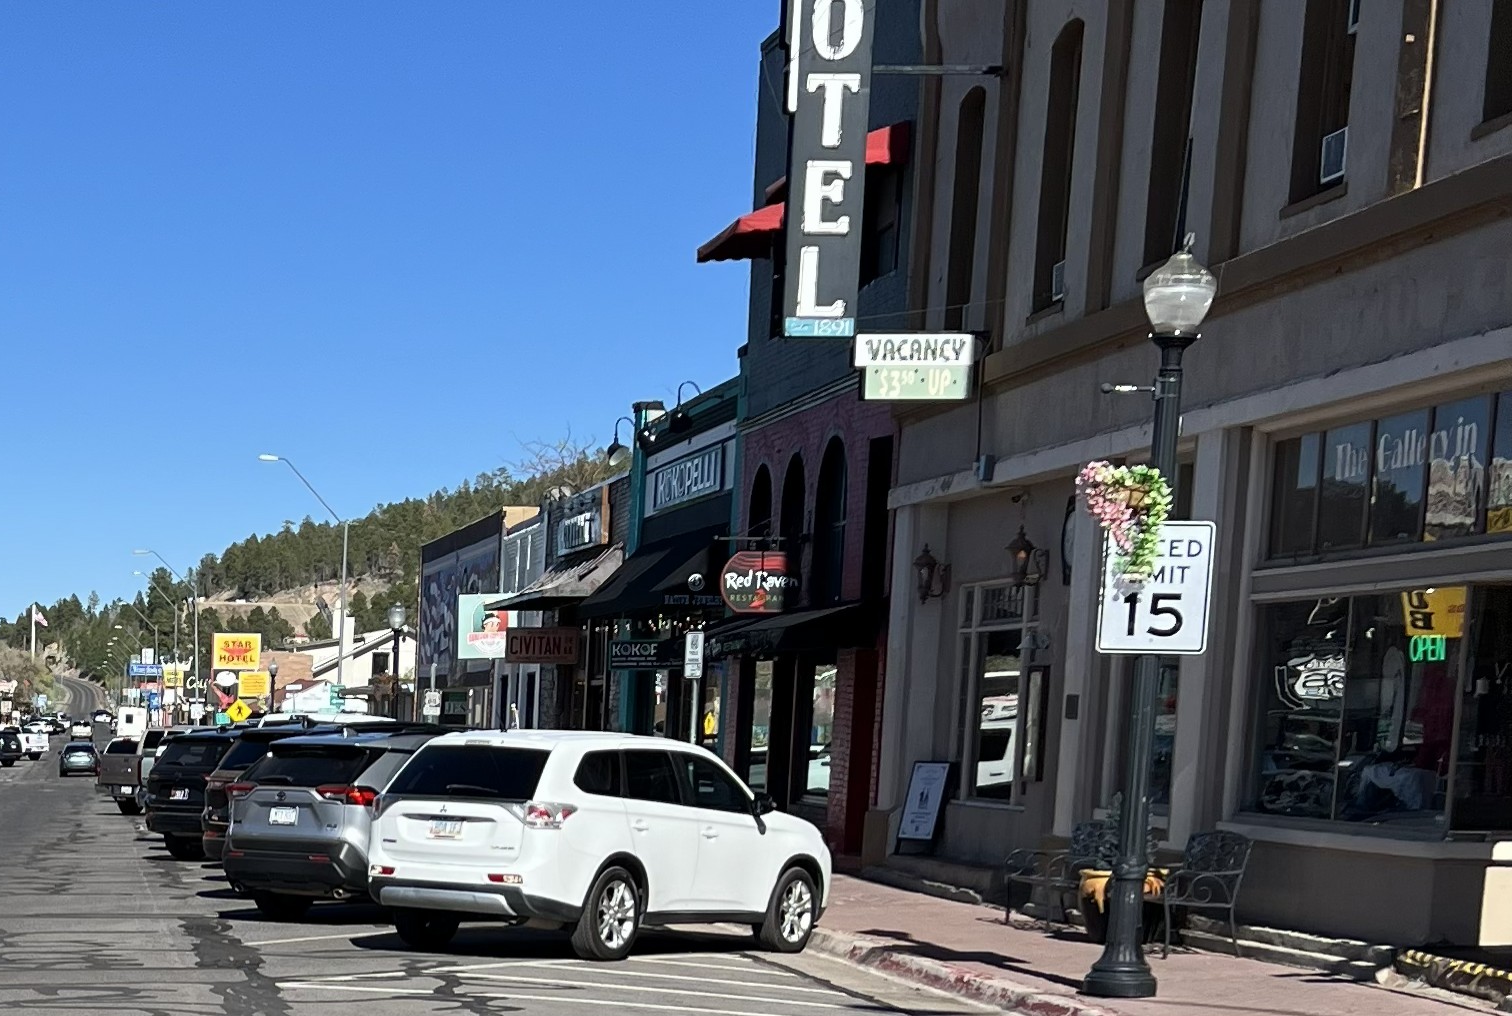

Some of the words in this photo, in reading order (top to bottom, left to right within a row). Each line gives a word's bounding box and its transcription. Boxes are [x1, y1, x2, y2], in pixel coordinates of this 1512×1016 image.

[814, 318, 850, 336] 1891
[865, 338, 967, 362] VACANCY
[928, 368, 952, 396] UP
[1335, 442, 1368, 481] The
[1377, 427, 1454, 473] Gallery
[656, 450, 717, 505] KOKOPELLI
[724, 569, 754, 590] Red
[1123, 592, 1183, 637] 15
[223, 640, 252, 649] STAR
[510, 635, 562, 656] CIVITAN
[1409, 634, 1447, 662] OPEN
